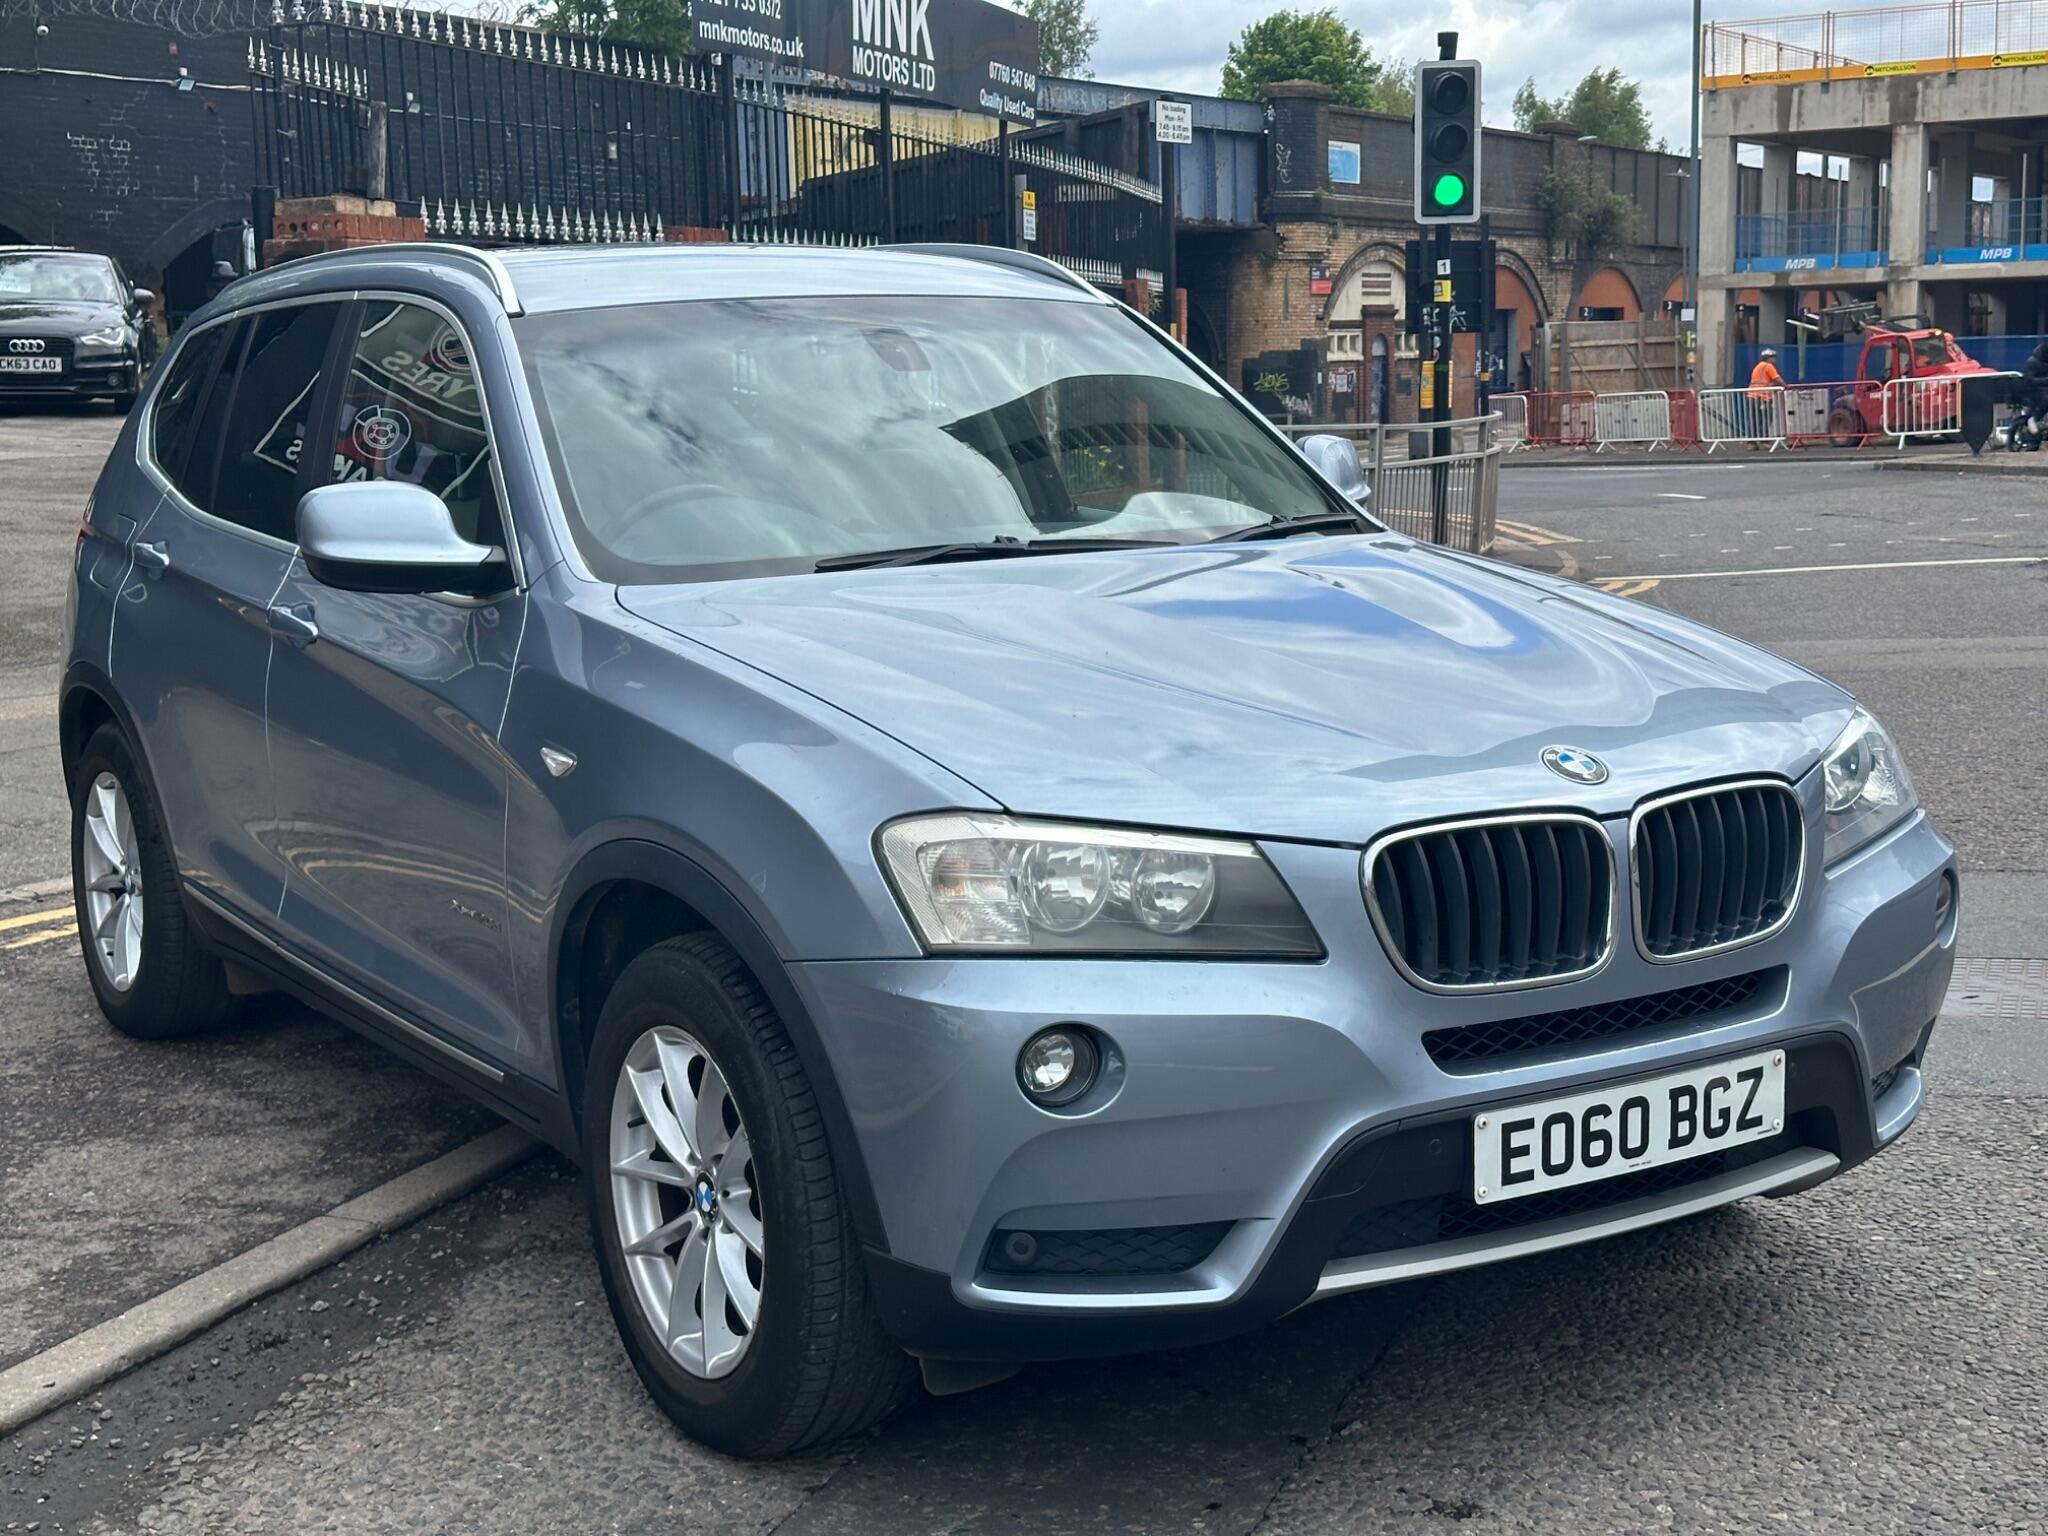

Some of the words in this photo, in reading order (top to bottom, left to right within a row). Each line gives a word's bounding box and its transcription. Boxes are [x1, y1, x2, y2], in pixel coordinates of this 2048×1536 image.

[699, 19, 804, 58] mnkmotors.co.uk
[853, 0, 935, 61] MNK
[852, 45, 909, 85] MOTORS
[912, 61, 936, 92] LTD
[1011, 67, 1023, 88] 547
[980, 88, 1003, 114] Quality
[1004, 95, 1020, 115] Used
[1021, 100, 1034, 120] Cars
[1440, 261, 1447, 272] 1
[1785, 258, 1816, 270] MPB
[1980, 247, 2013, 260] MPB
[0, 358, 30, 369] CK63
[33, 359, 56, 370] CAO
[1500, 1096, 1650, 1186] EO60
[1668, 1066, 1764, 1150] BGZ
